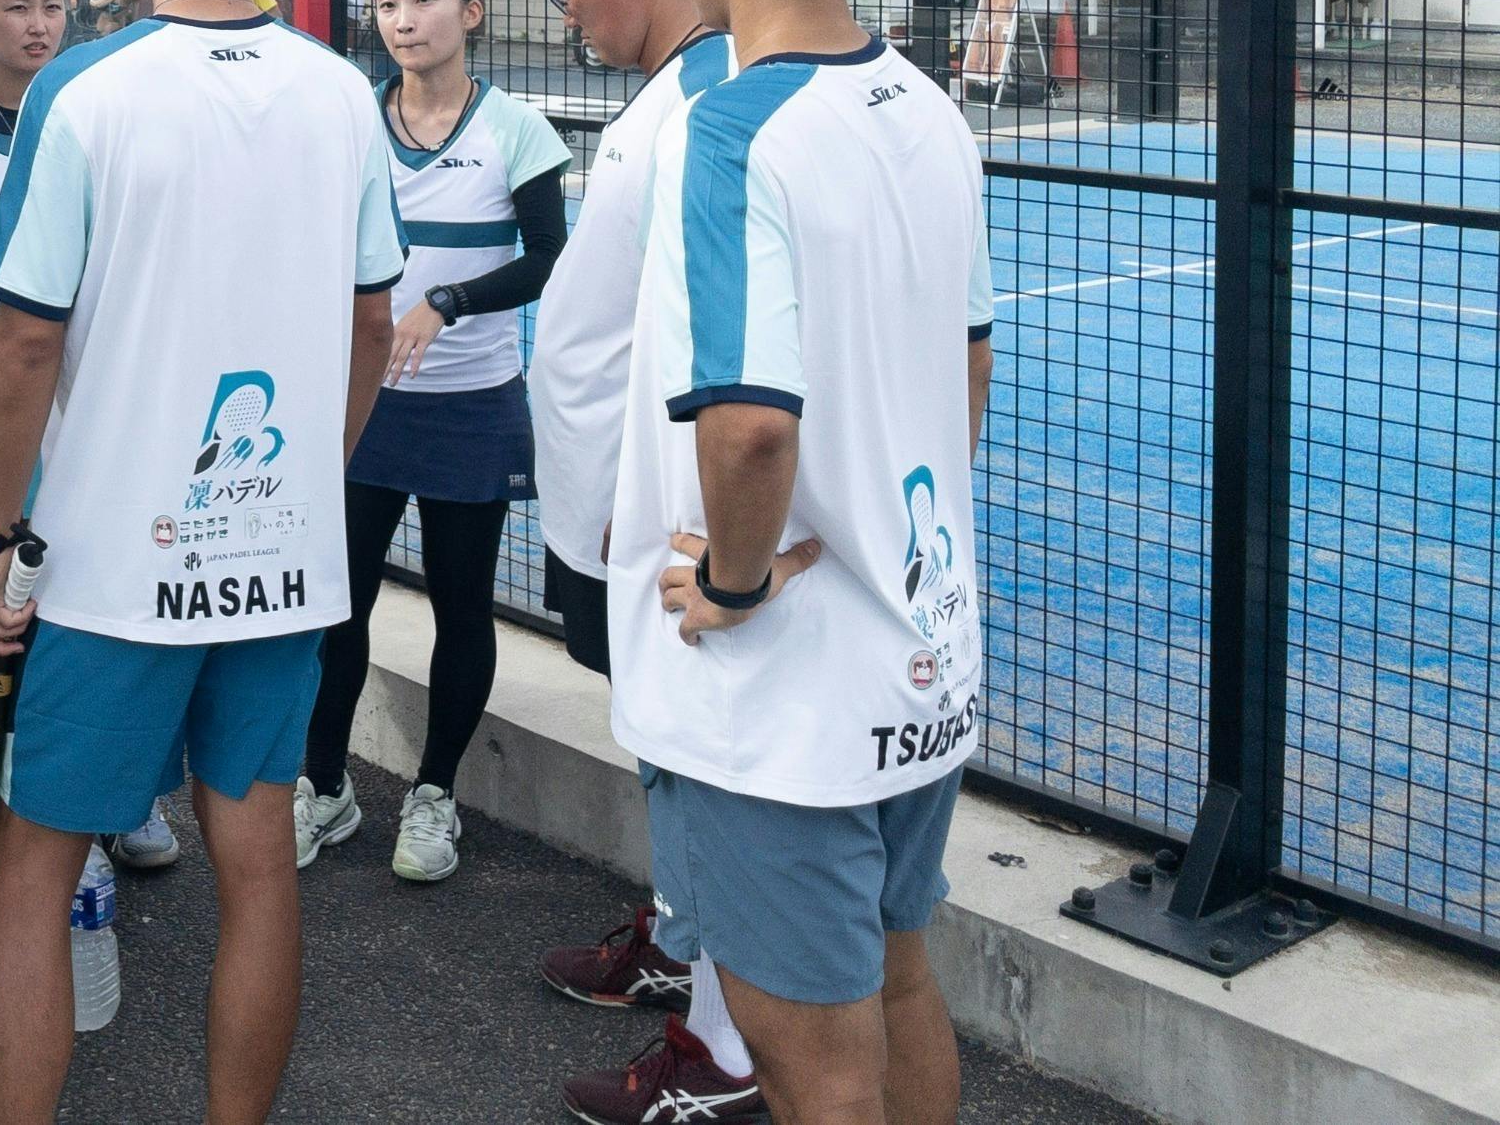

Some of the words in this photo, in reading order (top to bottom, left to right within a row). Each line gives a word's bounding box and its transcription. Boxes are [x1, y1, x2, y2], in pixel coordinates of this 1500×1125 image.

[206, 552, 228, 564] JAPAN
[229, 550, 252, 561] PADEL
[252, 547, 281, 558] LEAGUE
[156, 568, 306, 621] NASA.H
[871, 692, 978, 771] TSUBAS
